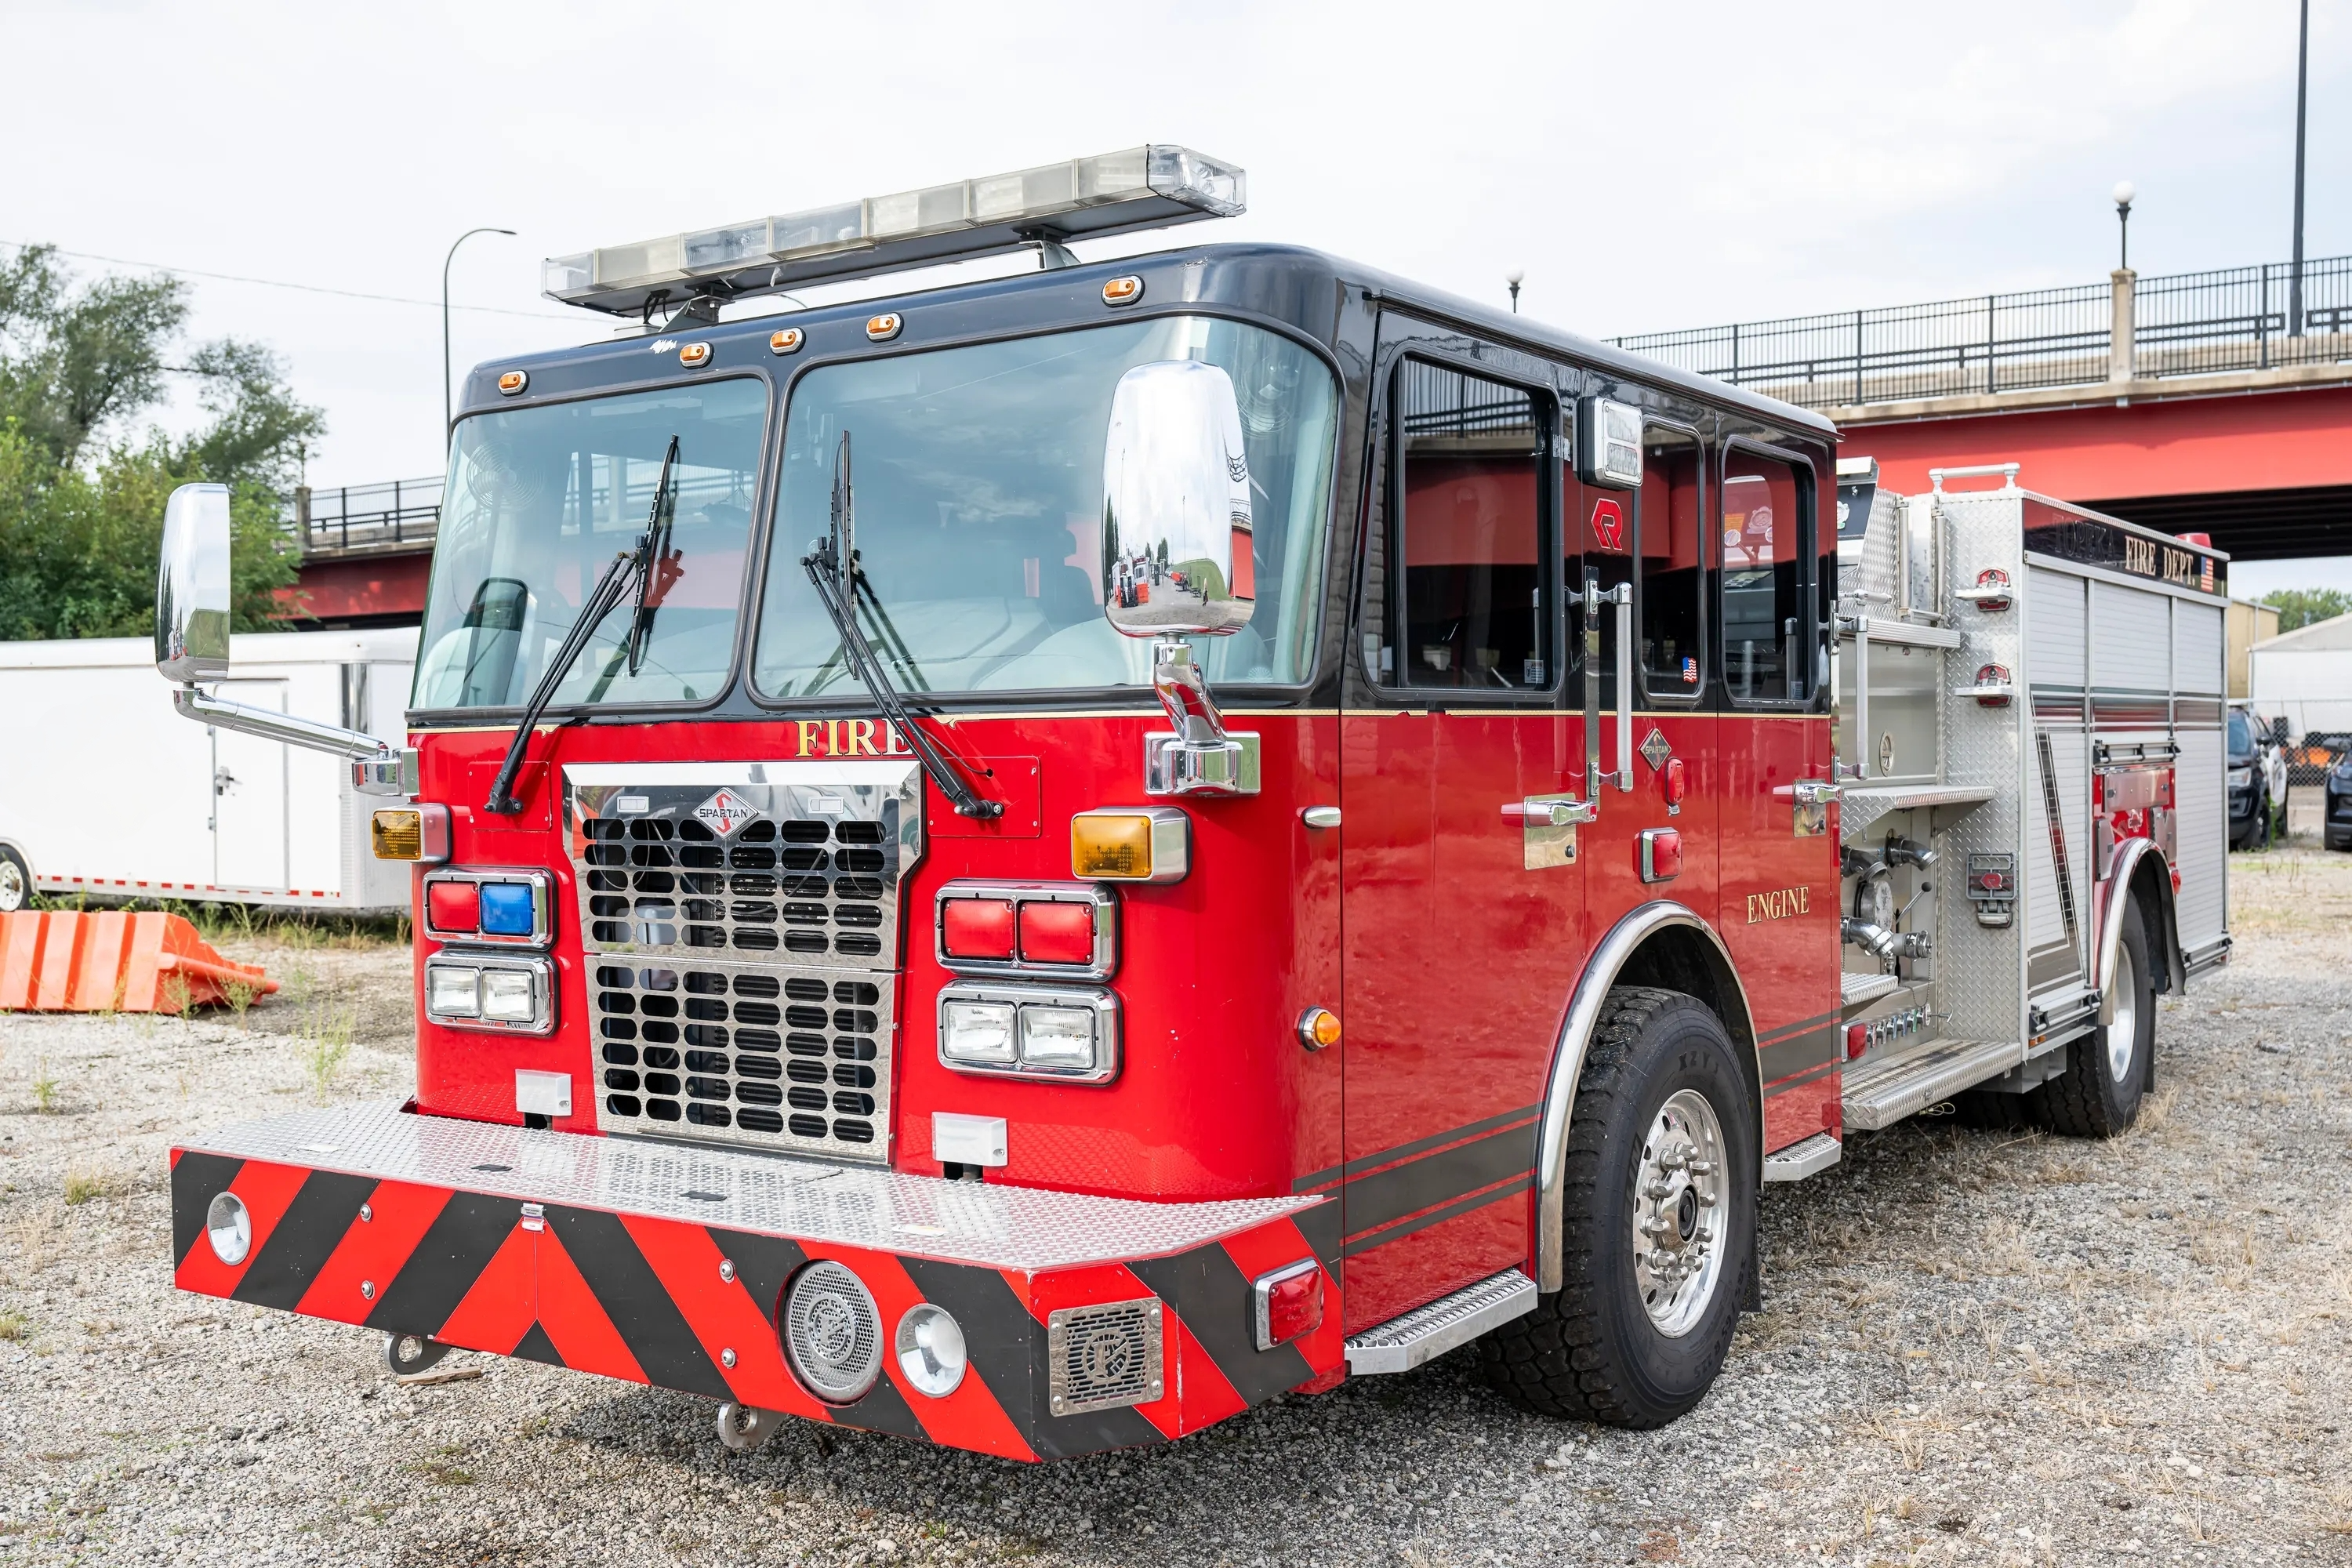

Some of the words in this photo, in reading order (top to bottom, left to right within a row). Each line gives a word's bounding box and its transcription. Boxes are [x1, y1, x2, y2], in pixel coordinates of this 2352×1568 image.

[2125, 535, 2157, 576] FIRE
[2162, 546, 2196, 586] DEPT.
[794, 718, 915, 757] FIRE
[1645, 745, 1668, 754] SPARTAN
[699, 808, 749, 818] SPARTAN
[1746, 885, 1810, 924] ENGINE
